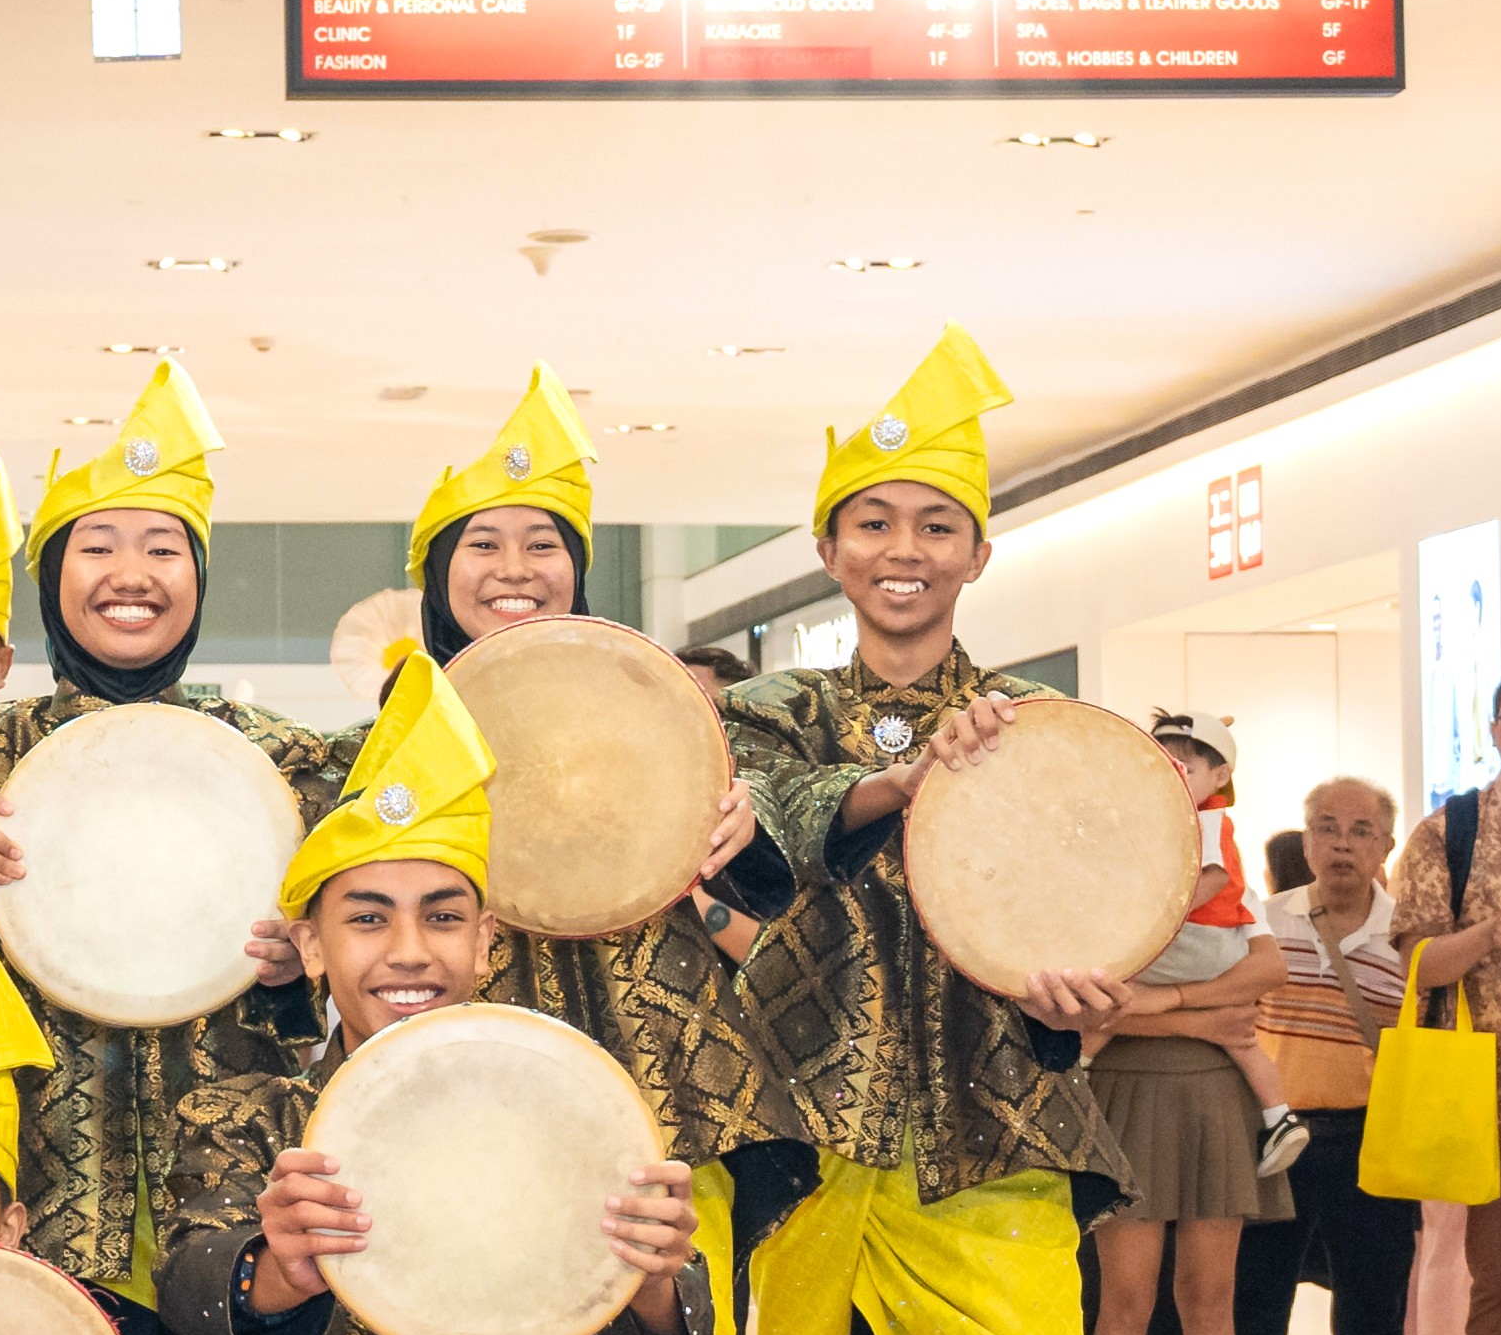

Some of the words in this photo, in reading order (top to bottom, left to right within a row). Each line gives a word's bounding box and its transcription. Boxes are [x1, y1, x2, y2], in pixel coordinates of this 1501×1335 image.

[313, 0, 371, 15] BEAUTY
[376, 0, 389, 14] &
[393, 0, 477, 14] PERSONAL
[481, 0, 527, 14] CARE
[314, 27, 371, 43] CLINIC
[616, 25, 636, 41] 1F
[705, 24, 783, 40] KARAOKE
[926, 23, 973, 40] 4F-5F
[1016, 23, 1048, 39] SPA
[1322, 24, 1342, 38] 5F
[315, 55, 387, 70] FASHION
[615, 53, 665, 69] LG-2F
[928, 52, 947, 67] 1F
[1016, 50, 1062, 68] TOYS,
[1067, 50, 1134, 66] HOBBIES
[1139, 51, 1152, 66] &
[1156, 51, 1238, 66] CHILDREN
[1322, 51, 1346, 65] GF
